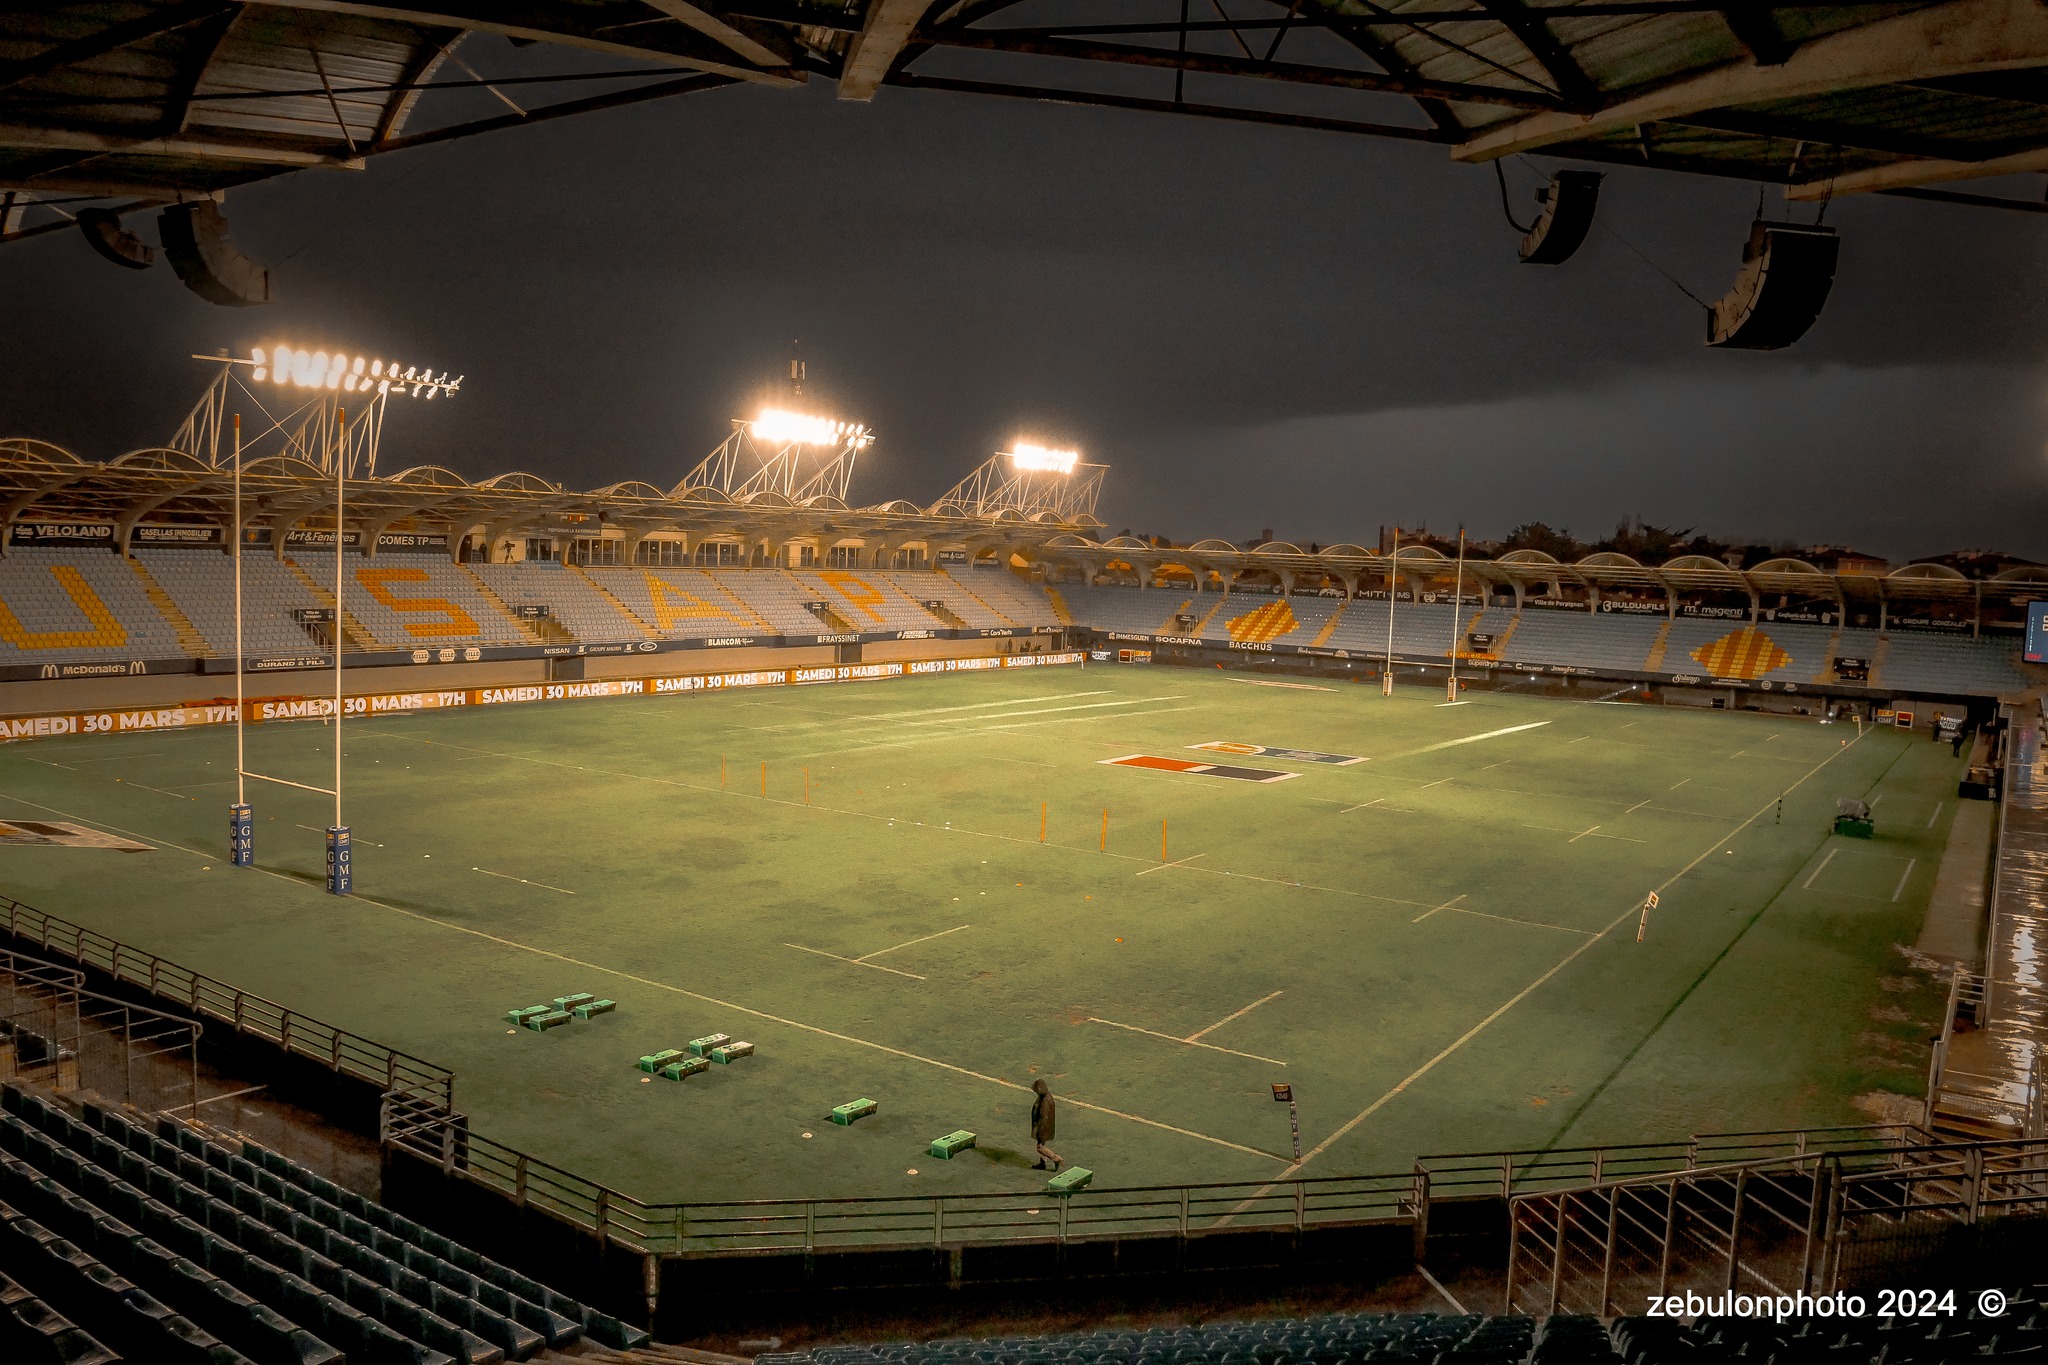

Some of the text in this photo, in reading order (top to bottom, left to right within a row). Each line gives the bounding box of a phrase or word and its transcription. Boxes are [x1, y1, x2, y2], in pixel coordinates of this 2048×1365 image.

[36, 525, 111, 537] VELOLAND
[174, 529, 212, 537] IMMOBILIER
[379, 536, 414, 545] COMES
[417, 536, 429, 545] TP
[708, 638, 741, 646] BLANCOM
[822, 634, 859, 642] FRAYSSINET
[1155, 636, 1202, 645] SOCAFNA
[1229, 641, 1272, 651] BACCHUS
[911, 661, 944, 673] SAMEDI
[946, 660, 956, 671] 30
[957, 658, 981, 669] MARS
[987, 657, 1000, 668] 17H
[1007, 656, 1035, 667] SAMEDI
[1036, 655, 1046, 665] 30
[1046, 654, 1066, 664] MARS
[63, 664, 126, 675] McDonald's
[796, 668, 836, 681] SAMEDI
[837, 667, 850, 678] 30
[852, 665, 880, 677] MARS
[887, 664, 902, 675] 17H
[656, 677, 704, 691] SAMEDI
[707, 676, 722, 688] 30
[725, 673, 758, 686] MARS
[767, 671, 786, 683] 17H
[482, 687, 542, 703] SAMEDI
[546, 685, 564, 699] 30
[568, 682, 608, 698] MARS
[621, 681, 643, 693] 17H
[344, 697, 367, 713] 30
[372, 694, 422, 711] MARS
[438, 692, 466, 707] 17H
[83, 714, 113, 731] 30
[119, 710, 186, 729] MARS
[205, 706, 239, 722] 17H
[241, 826, 251, 862] GMF
[327, 851, 335, 889] GMF
[339, 851, 349, 889] GMF
